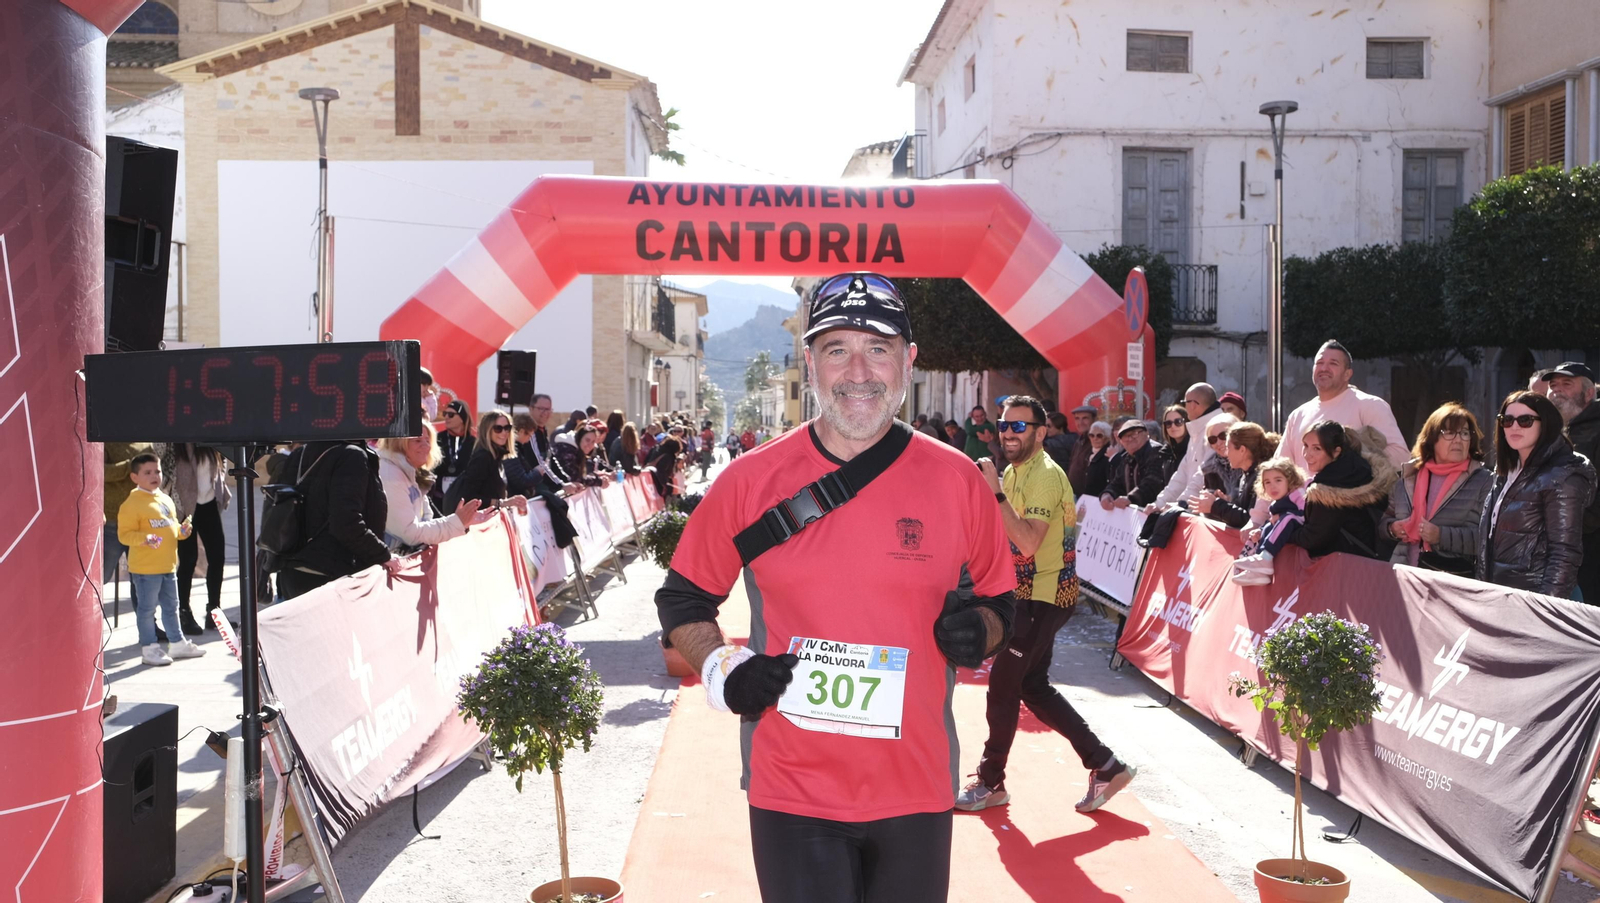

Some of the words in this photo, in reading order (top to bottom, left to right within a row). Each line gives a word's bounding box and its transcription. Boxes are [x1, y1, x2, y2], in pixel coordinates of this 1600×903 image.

[627, 183, 915, 208] AYUNTAMIENTO
[635, 219, 905, 263] CANTORIA
[167, 352, 399, 428] 1:57:58
[1076, 531, 1138, 580] CANTORIA
[1146, 591, 1211, 636] TEAMERGY
[799, 651, 811, 662] LA
[814, 653, 866, 669] PÓLVORA
[805, 639, 818, 649] IV
[806, 669, 882, 711] 307
[331, 683, 418, 782] TEAMERGY
[1374, 744, 1453, 792] www.teamergy.es
